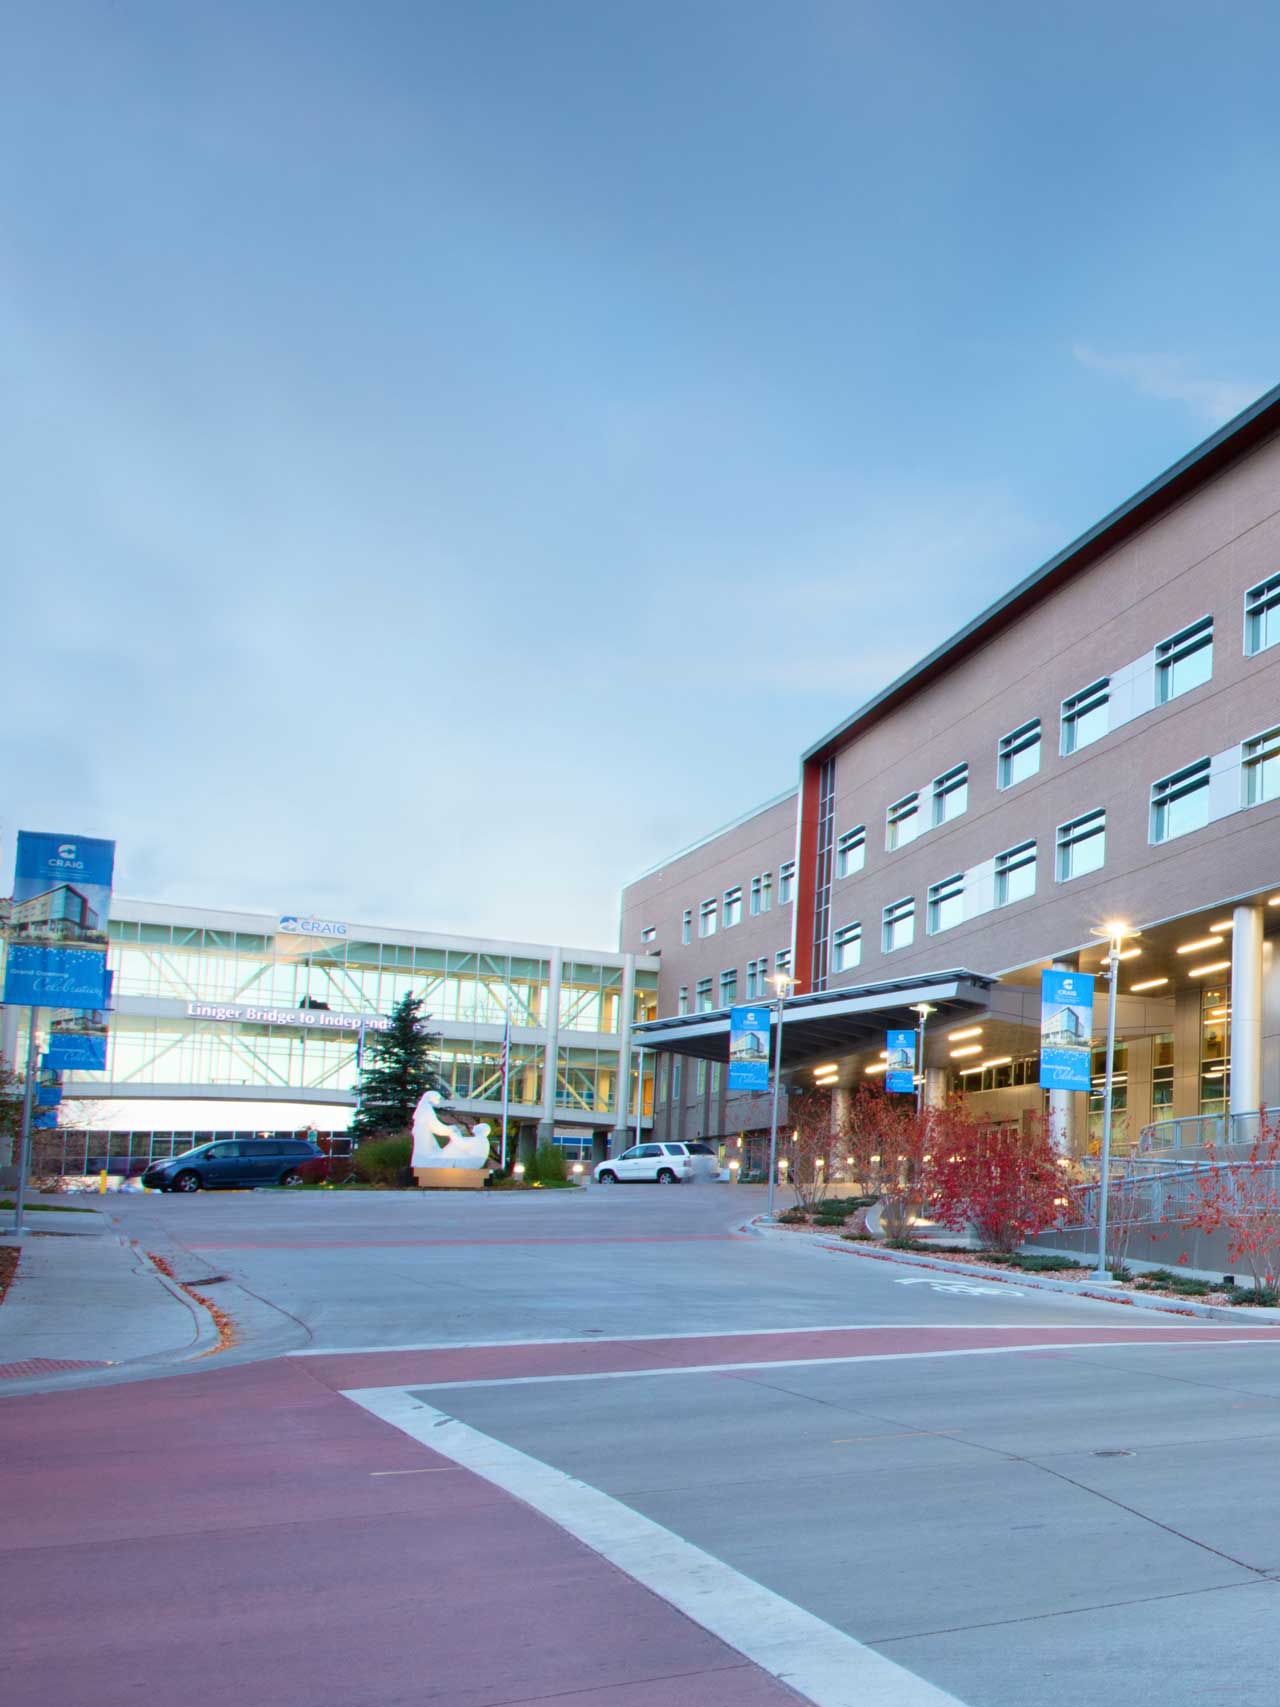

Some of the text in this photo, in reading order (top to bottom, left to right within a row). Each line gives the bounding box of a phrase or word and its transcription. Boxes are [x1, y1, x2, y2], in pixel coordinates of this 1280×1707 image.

[48, 858, 84, 869] CRAIG
[300, 921, 347, 936] CRAIG
[187, 1003, 242, 1020] Liniger
[246, 1007, 295, 1024] Bridge
[299, 1010, 316, 1024] to
